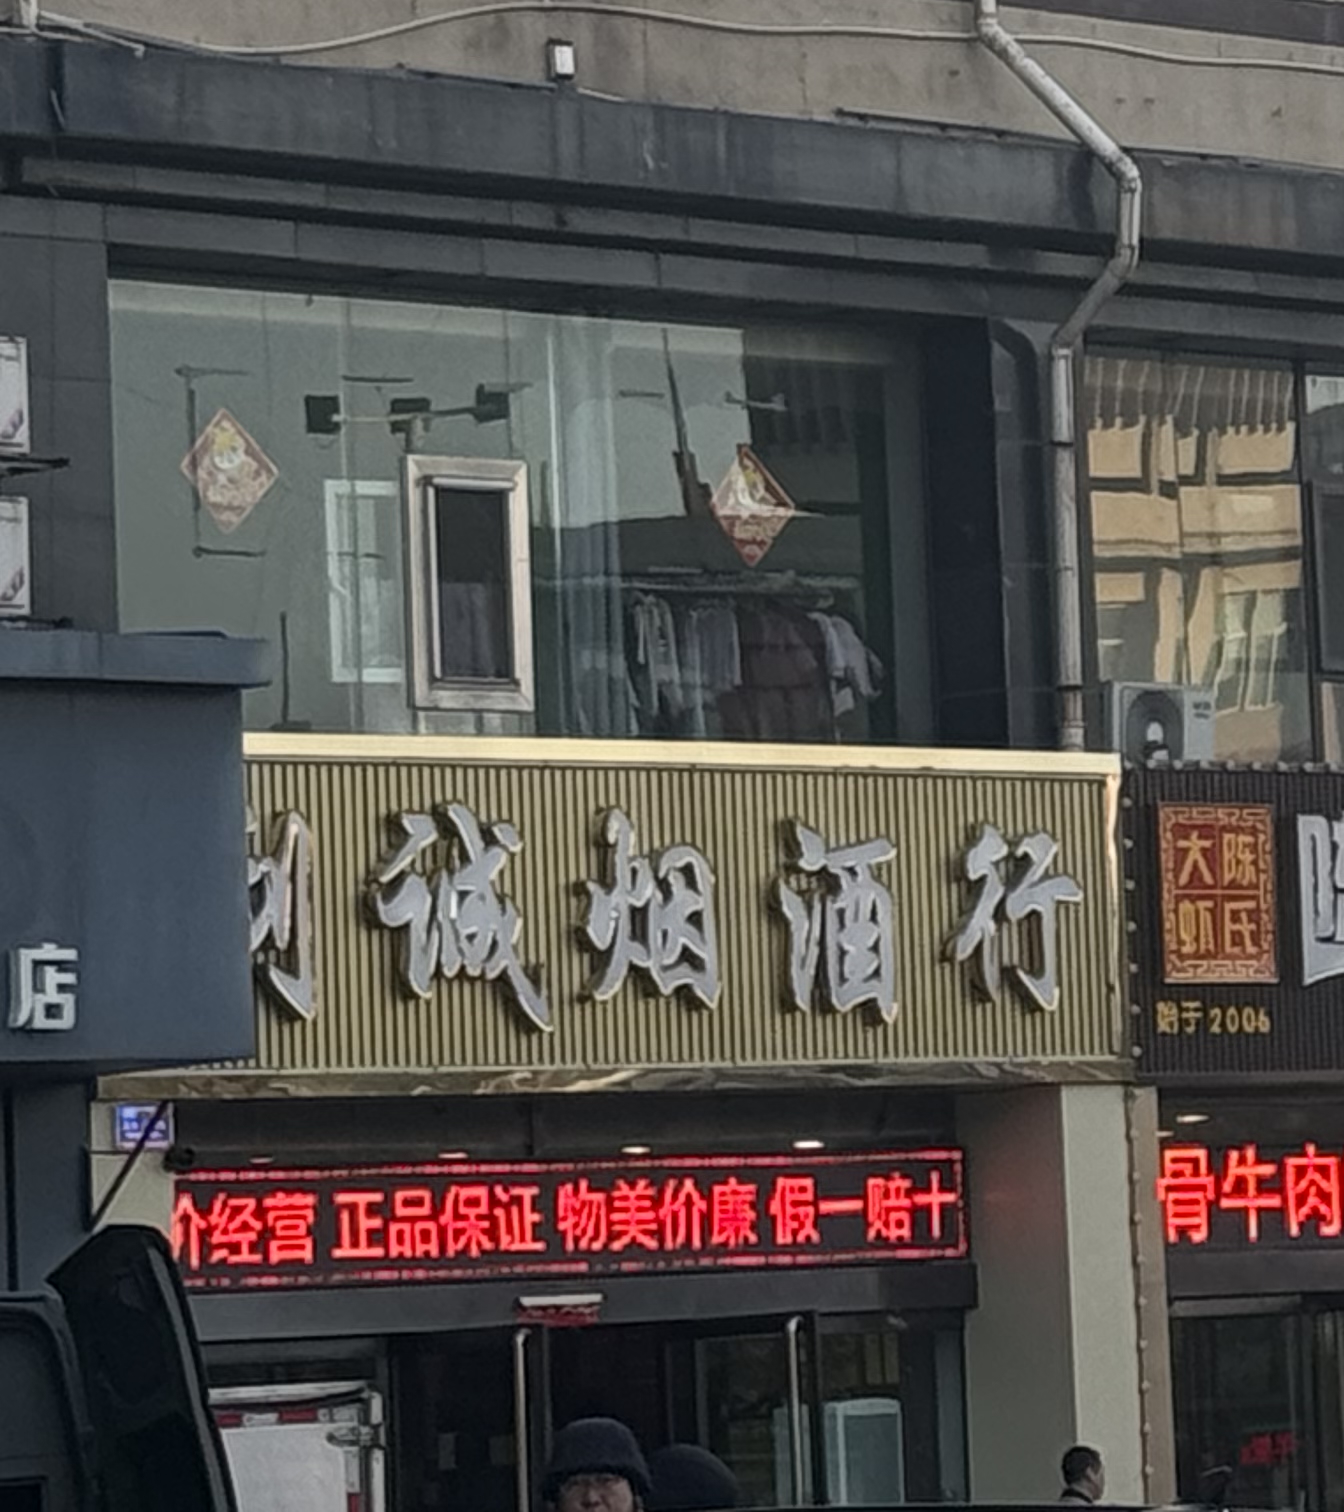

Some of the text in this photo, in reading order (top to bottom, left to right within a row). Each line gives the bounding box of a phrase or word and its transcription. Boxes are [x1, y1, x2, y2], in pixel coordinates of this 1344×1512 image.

[9, 943, 79, 1031] 店
[1156, 1001, 1271, 1034] 始于 2006
[332, 1183, 545, 1260] 正品保证
[556, 1178, 758, 1253] 物美价廉
[768, 1170, 958, 1246] 假一赔十
